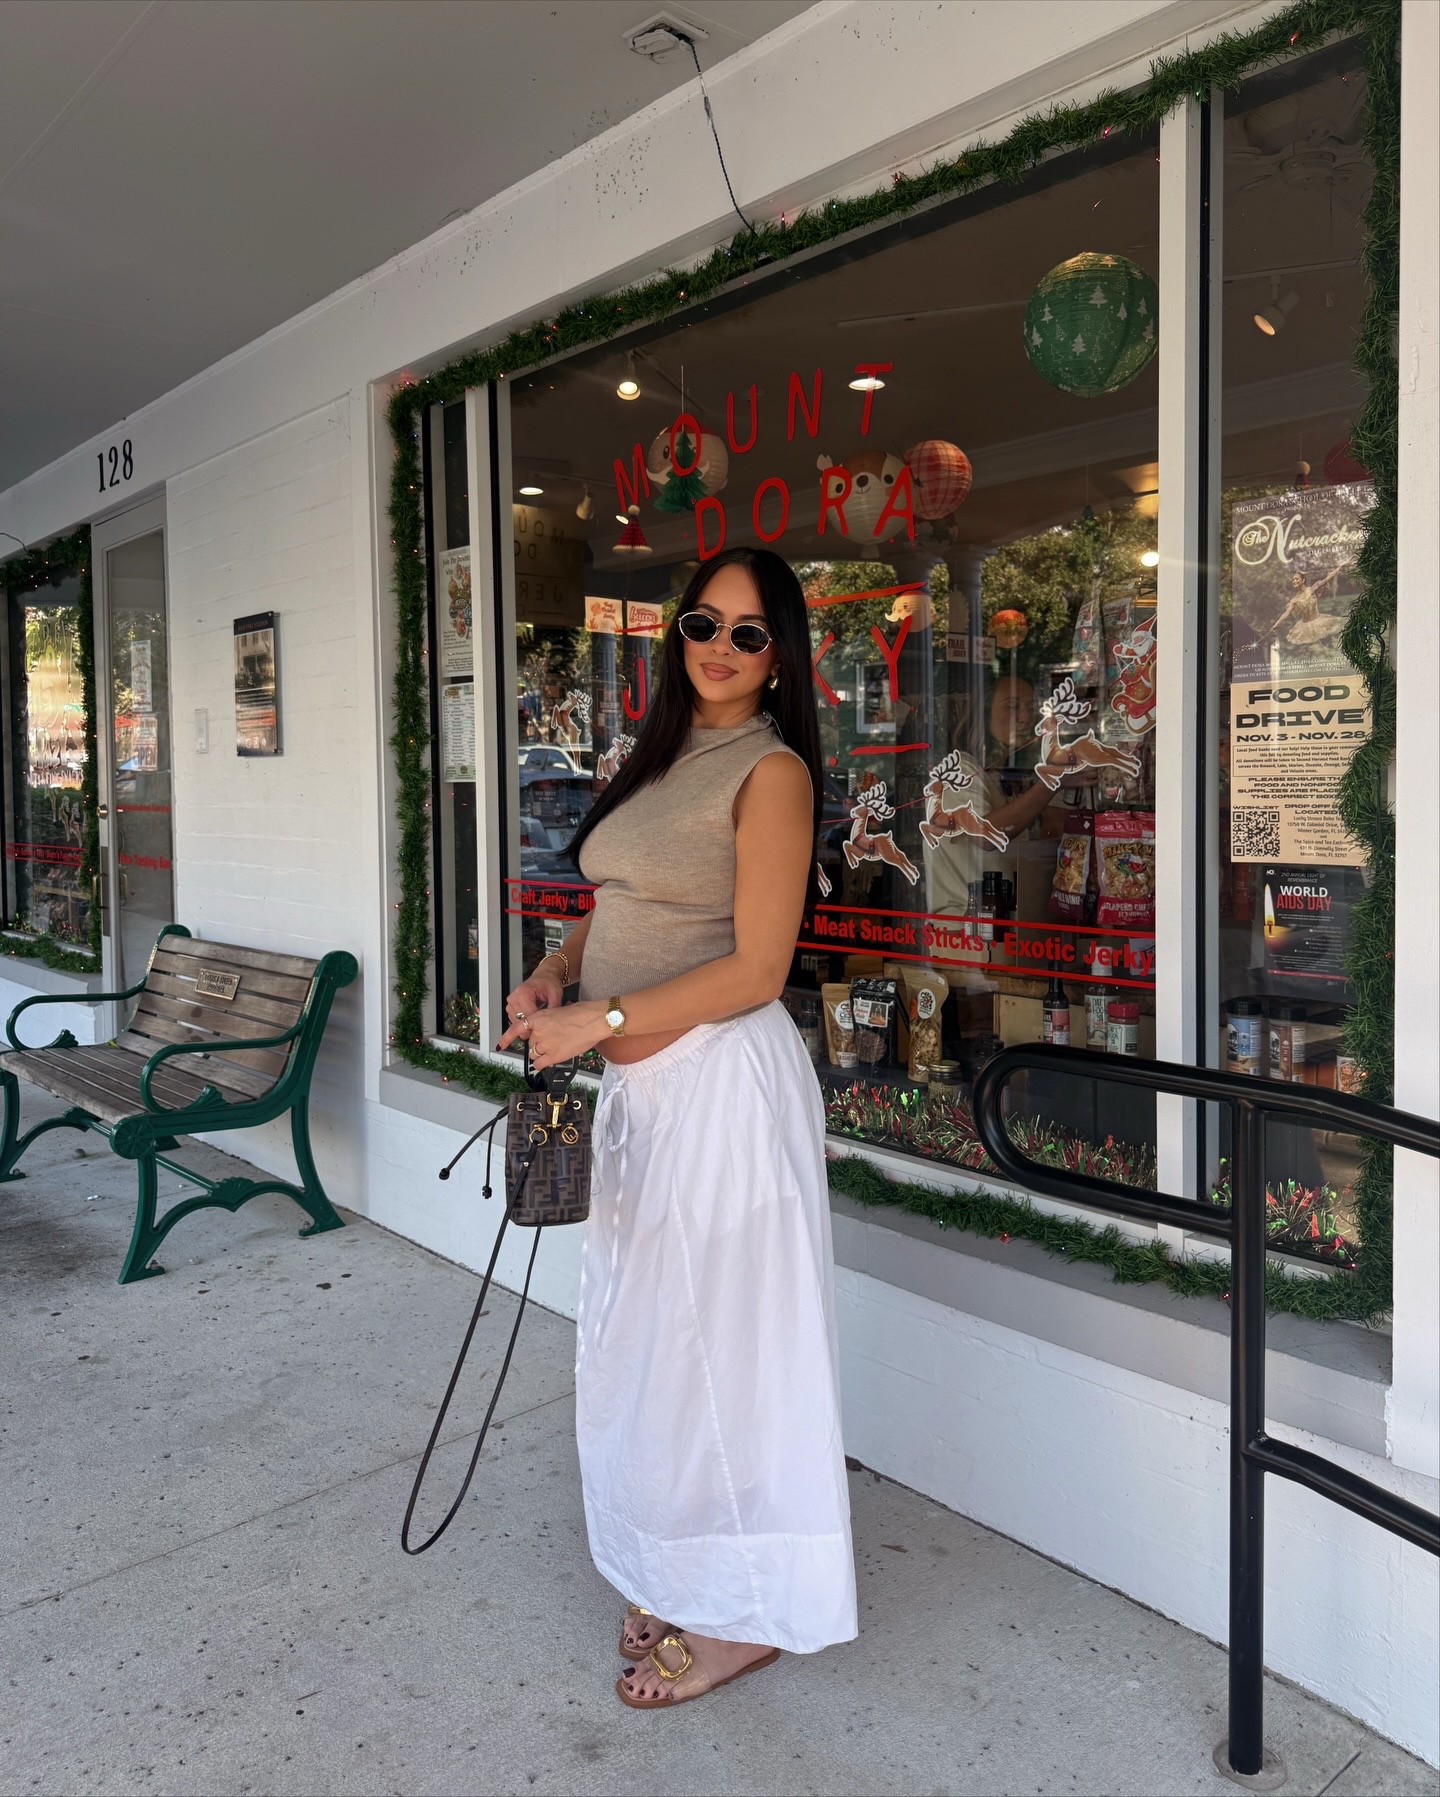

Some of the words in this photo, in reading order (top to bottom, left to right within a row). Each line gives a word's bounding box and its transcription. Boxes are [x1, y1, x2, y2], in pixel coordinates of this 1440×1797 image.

[612, 362, 893, 513] MOUNT
[97, 439, 133, 493] 128
[694, 465, 915, 561] DORA
[1236, 503, 1265, 513] MOUNT
[1242, 530, 1269, 546] The
[1248, 685, 1351, 705] FOOD
[1236, 708, 1364, 728] DRIVE
[1236, 734, 1273, 742] NOV.
[1299, 731, 1338, 740] NOV.
[1340, 730, 1366, 739] 28
[511, 887, 536, 905] Craft
[538, 889, 568, 912] Jerky
[1280, 885, 1328, 898] WORLD
[1276, 893, 1304, 910] AIDS
[1307, 895, 1332, 912] DAY
[813, 914, 855, 938] Meat
[860, 919, 915, 946] Snack
[921, 924, 984, 952] Sticks
[1003, 932, 1075, 963] Exotic
[1083, 940, 1155, 978] Jerky
